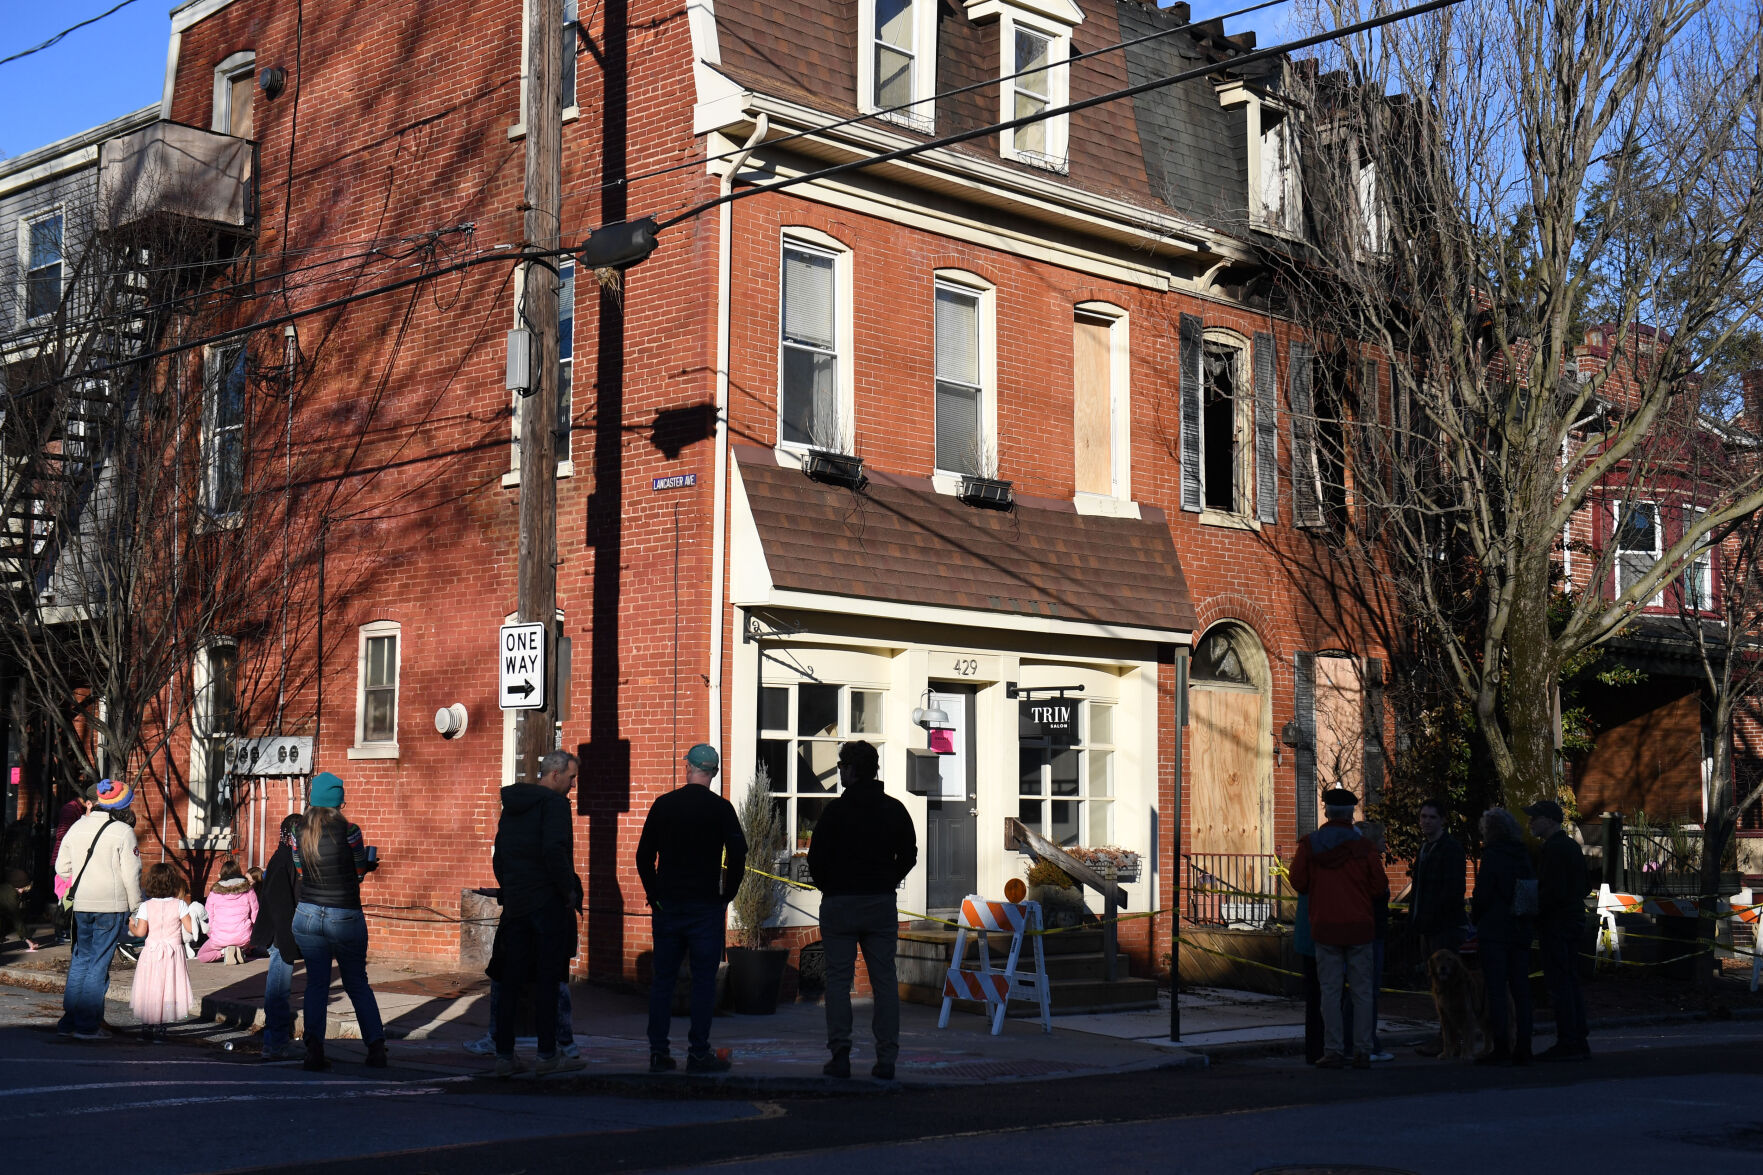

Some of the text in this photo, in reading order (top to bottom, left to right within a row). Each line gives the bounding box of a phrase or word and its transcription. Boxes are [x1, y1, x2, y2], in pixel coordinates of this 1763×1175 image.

[653, 474, 695, 490] LANCASTER AVE
[506, 631, 538, 652] ONE
[505, 654, 538, 675] WAY
[953, 659, 978, 676] 429
[1031, 706, 1070, 723] TRIM
